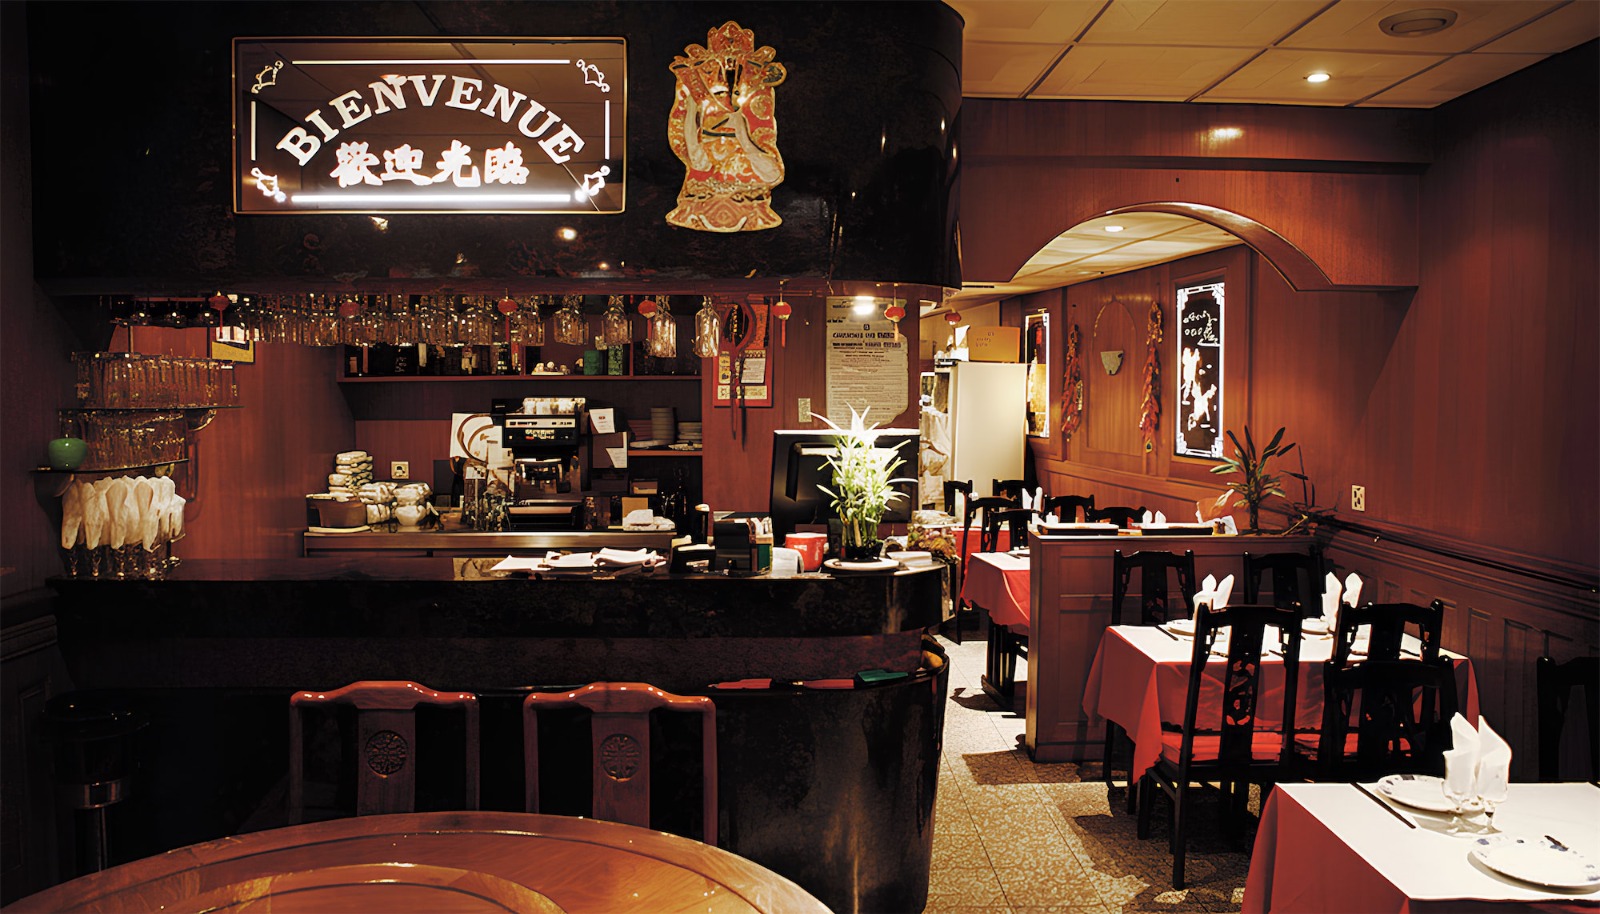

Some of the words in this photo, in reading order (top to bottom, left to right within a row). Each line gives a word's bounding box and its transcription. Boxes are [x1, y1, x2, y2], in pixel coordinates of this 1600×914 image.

[276, 74, 586, 166] BIENVENUE
[329, 139, 530, 188] 歡迎光臨
